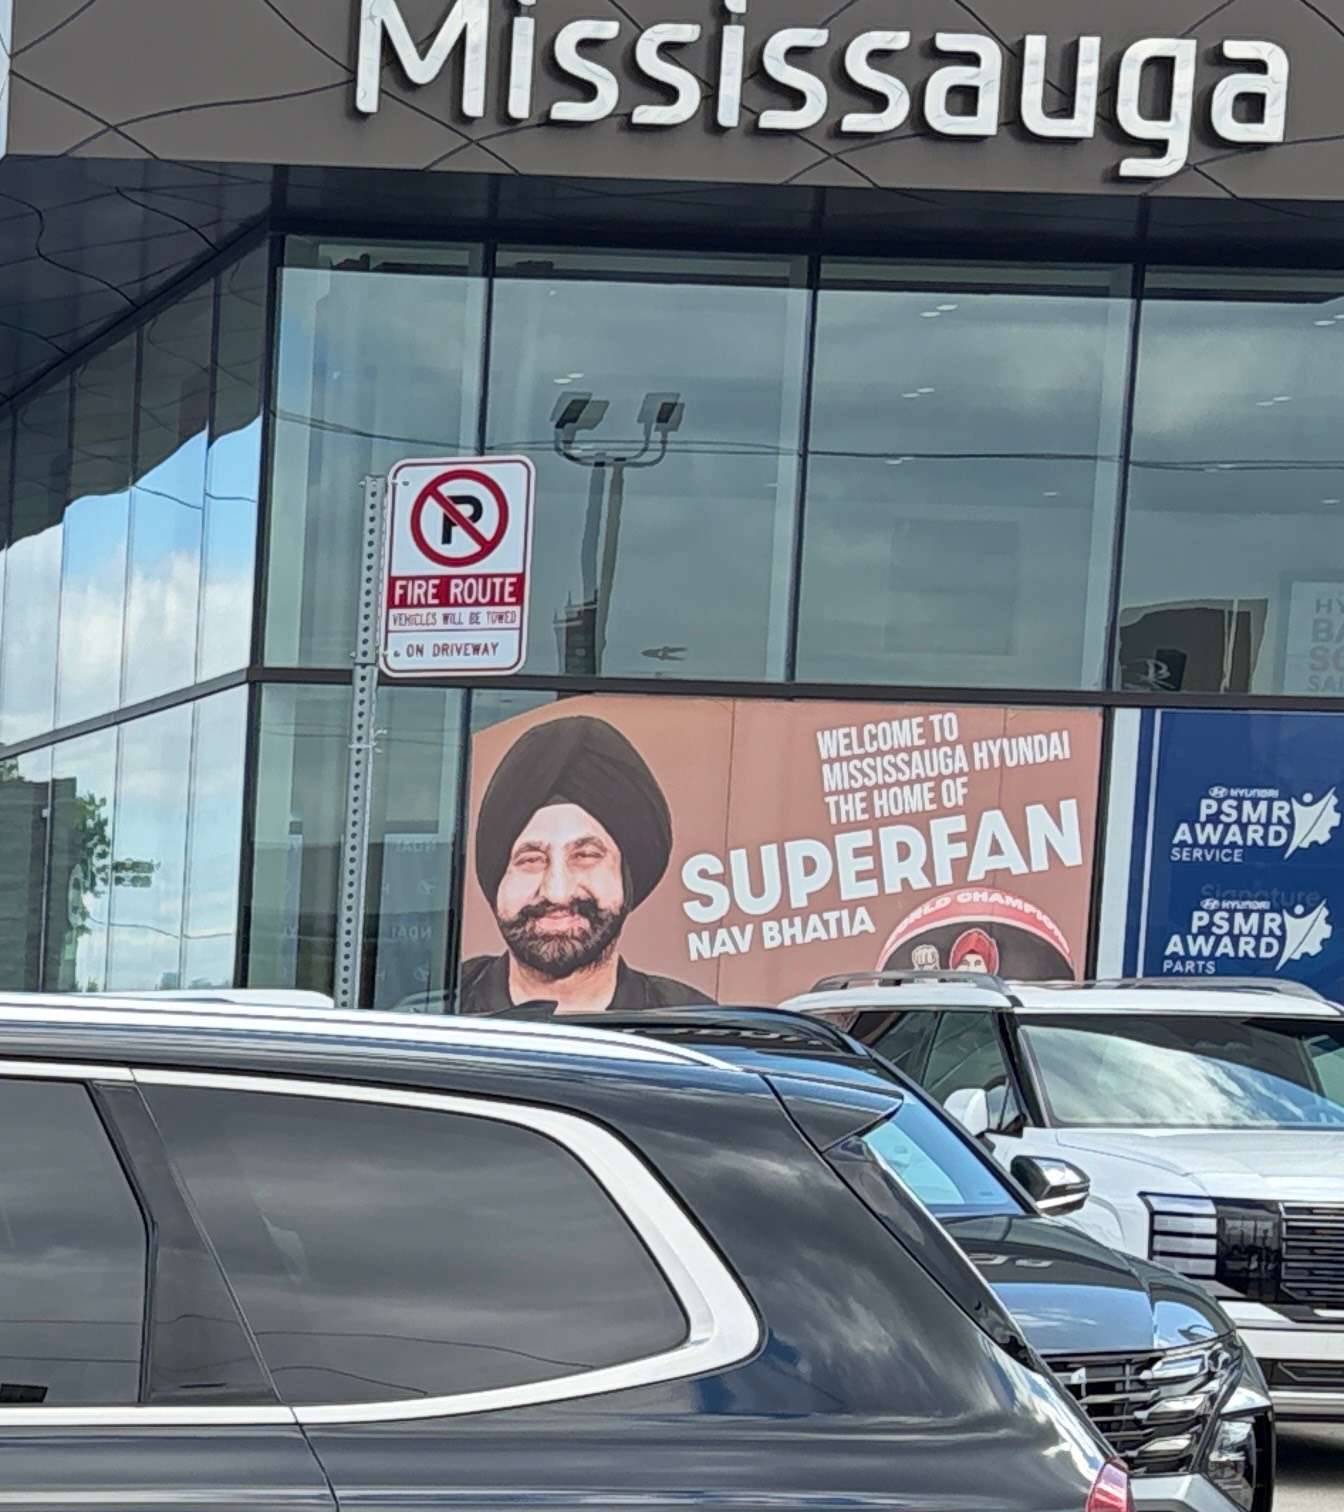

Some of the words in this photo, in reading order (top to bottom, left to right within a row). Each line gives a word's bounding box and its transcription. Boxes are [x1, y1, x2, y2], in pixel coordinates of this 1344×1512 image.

[355, 0, 1291, 178] Mississauga
[393, 579, 441, 606] FIRE
[449, 577, 517, 605] ROUTE
[392, 611, 438, 627] VEHICLES
[441, 612, 464, 626] WILL
[468, 611, 482, 625] BE
[486, 610, 517, 625] TOWED
[406, 643, 425, 658] ON
[431, 641, 500, 658] DRIVEWAY
[816, 716, 927, 760] WELCOME
[928, 711, 960, 743] TO
[821, 744, 969, 793] MISSISSAUGA
[972, 729, 1072, 771] HYUNDAI
[823, 790, 870, 825] THE
[873, 781, 938, 818] HOME
[940, 776, 969, 808] OF
[1199, 798, 1292, 825] PSMR
[1172, 822, 1289, 847] AWARD
[680, 798, 1083, 924] SUPERFAN
[1170, 847, 1244, 862] SERVICE
[687, 924, 754, 961] NAV
[761, 906, 876, 950] BHATIA
[1191, 910, 1283, 936] PSMR
[1164, 934, 1280, 959] AWARD
[1162, 960, 1216, 975] PARTS
